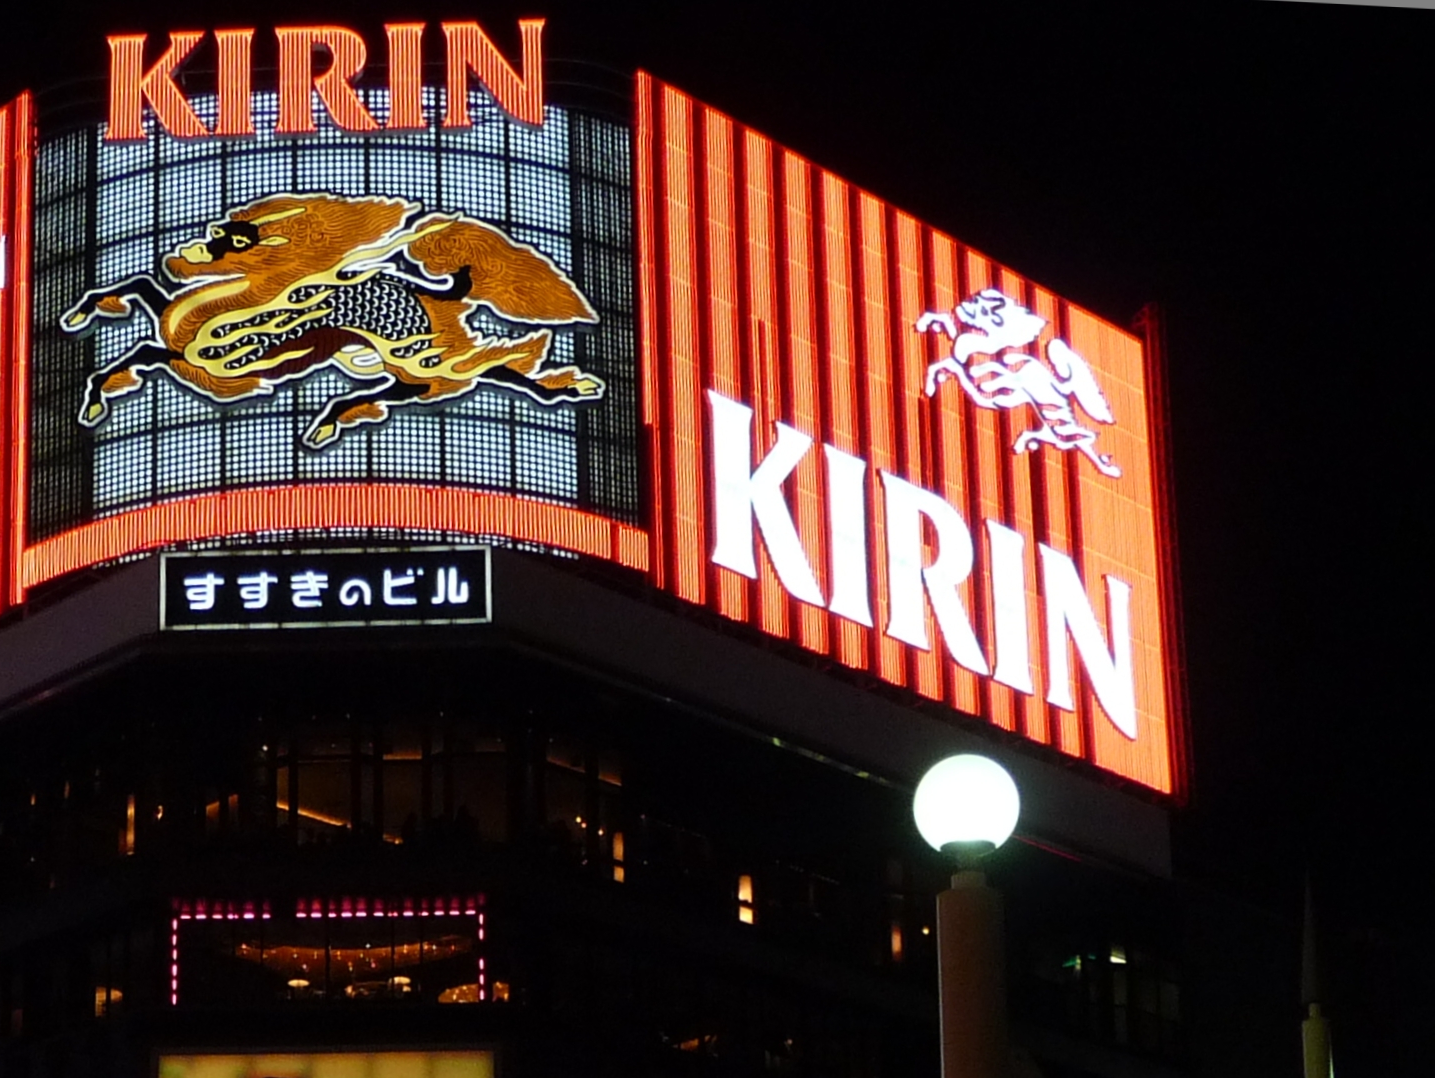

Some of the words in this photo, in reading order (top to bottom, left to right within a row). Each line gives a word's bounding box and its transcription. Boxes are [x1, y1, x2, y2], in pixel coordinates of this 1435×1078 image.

[103, 18, 546, 141] KIRIN
[183, 567, 469, 610] すすきのビル
[707, 388, 1138, 741] KIRIN
